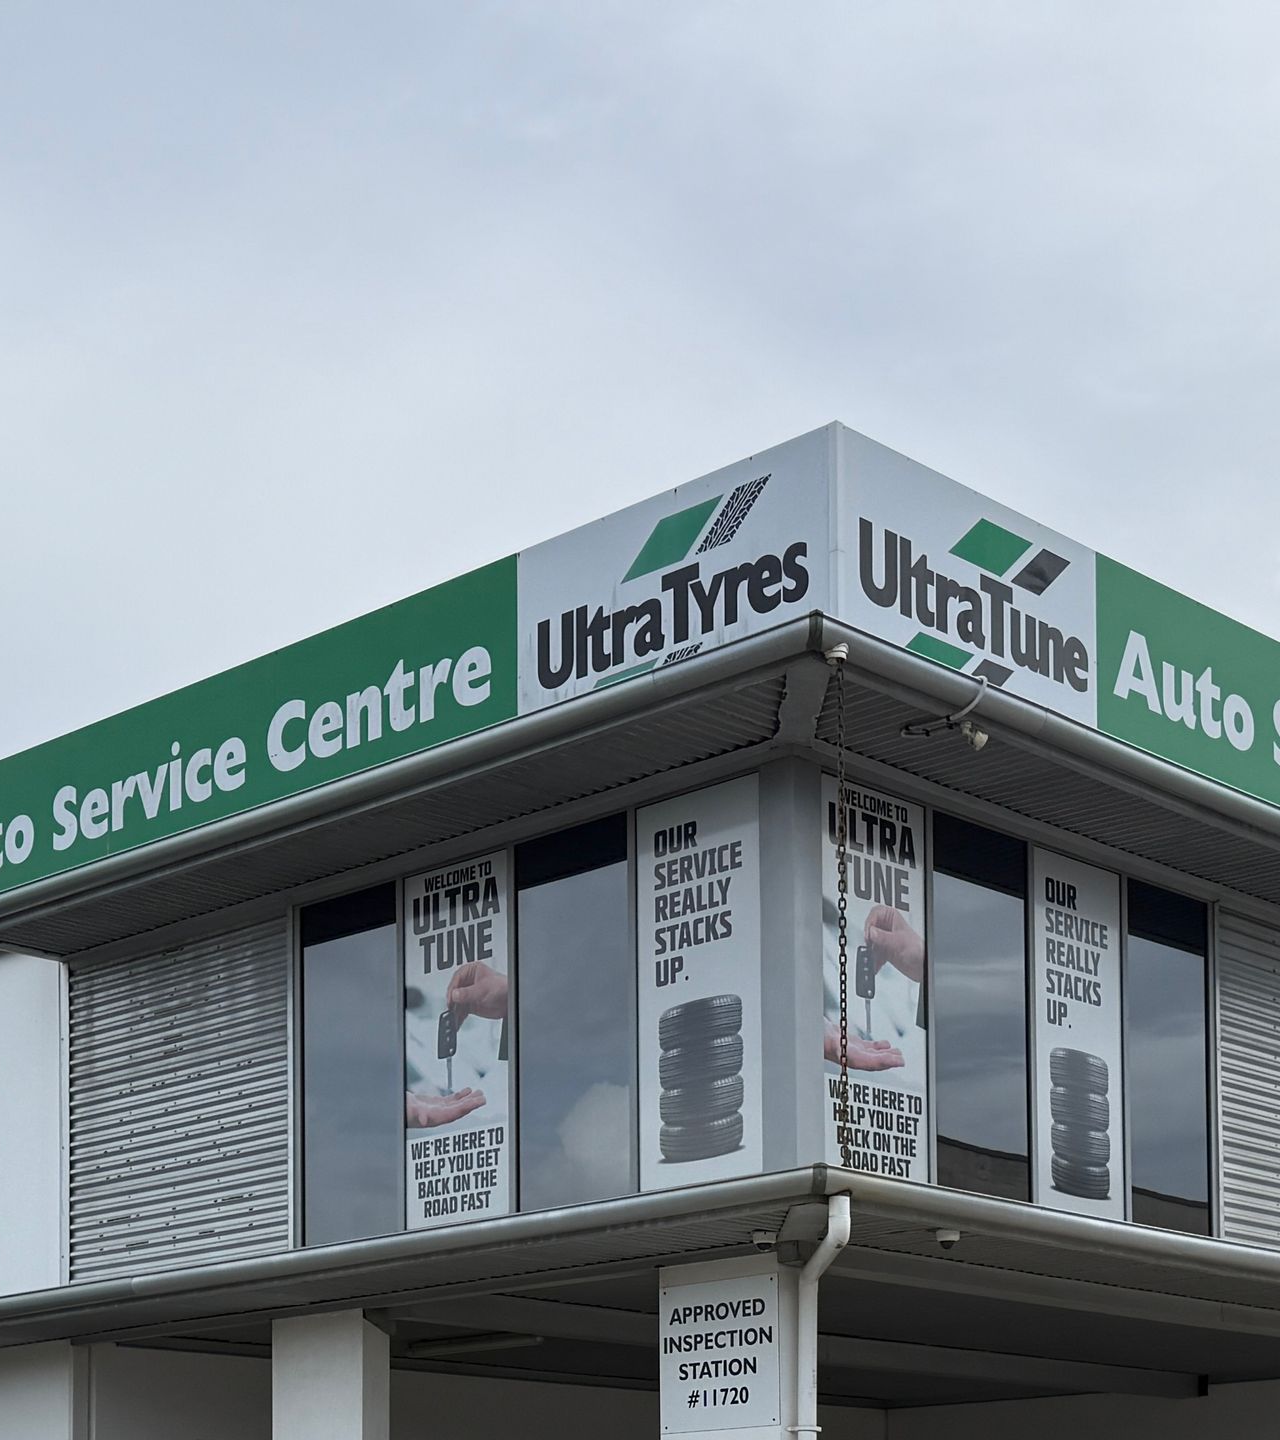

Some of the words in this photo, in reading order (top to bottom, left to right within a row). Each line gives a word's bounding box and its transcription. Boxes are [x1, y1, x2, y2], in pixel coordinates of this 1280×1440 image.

[536, 541, 809, 692] UltraTyres
[1113, 629, 1255, 752] Auto
[52, 741, 246, 852] Service
[266, 645, 492, 772] Centre
[894, 804, 908, 823] TO
[654, 820, 698, 858] OUR
[424, 865, 476, 892] WELCOME
[478, 860, 492, 878] TO
[654, 840, 742, 890] SERVICE
[413, 876, 500, 935] ULTRA
[655, 876, 731, 923] REALLY
[1045, 877, 1076, 910] OUR
[655, 910, 732, 956] STACKS
[1046, 908, 1108, 950] SERVICE
[420, 920, 492, 974] TUNE
[1046, 938, 1100, 976] REALLY
[1046, 968, 1102, 1006] STACKS
[872, 1088, 904, 1112] HERE
[906, 1094, 922, 1115] TO
[868, 1108, 893, 1131] YOU
[896, 1114, 920, 1136] GET
[411, 1136, 450, 1160] WE'RE
[453, 1130, 485, 1152] HERE
[488, 1126, 504, 1146] TO
[873, 1132, 890, 1153] ON
[893, 1136, 916, 1158] THE
[415, 1158, 445, 1180] HELP
[448, 1152, 473, 1173] YOU
[477, 1148, 500, 1168] GET
[882, 1155, 911, 1178] FAST
[418, 1177, 450, 1199] BACK
[453, 1173, 470, 1192] ON
[473, 1169, 496, 1189] THE
[424, 1196, 458, 1218] ROAD
[461, 1190, 491, 1212] FAST
[670, 1298, 766, 1326] APPROVED
[664, 1326, 772, 1354] INSPECTION
[679, 1356, 757, 1380] STATION
[688, 1386, 748, 1408] #11720
